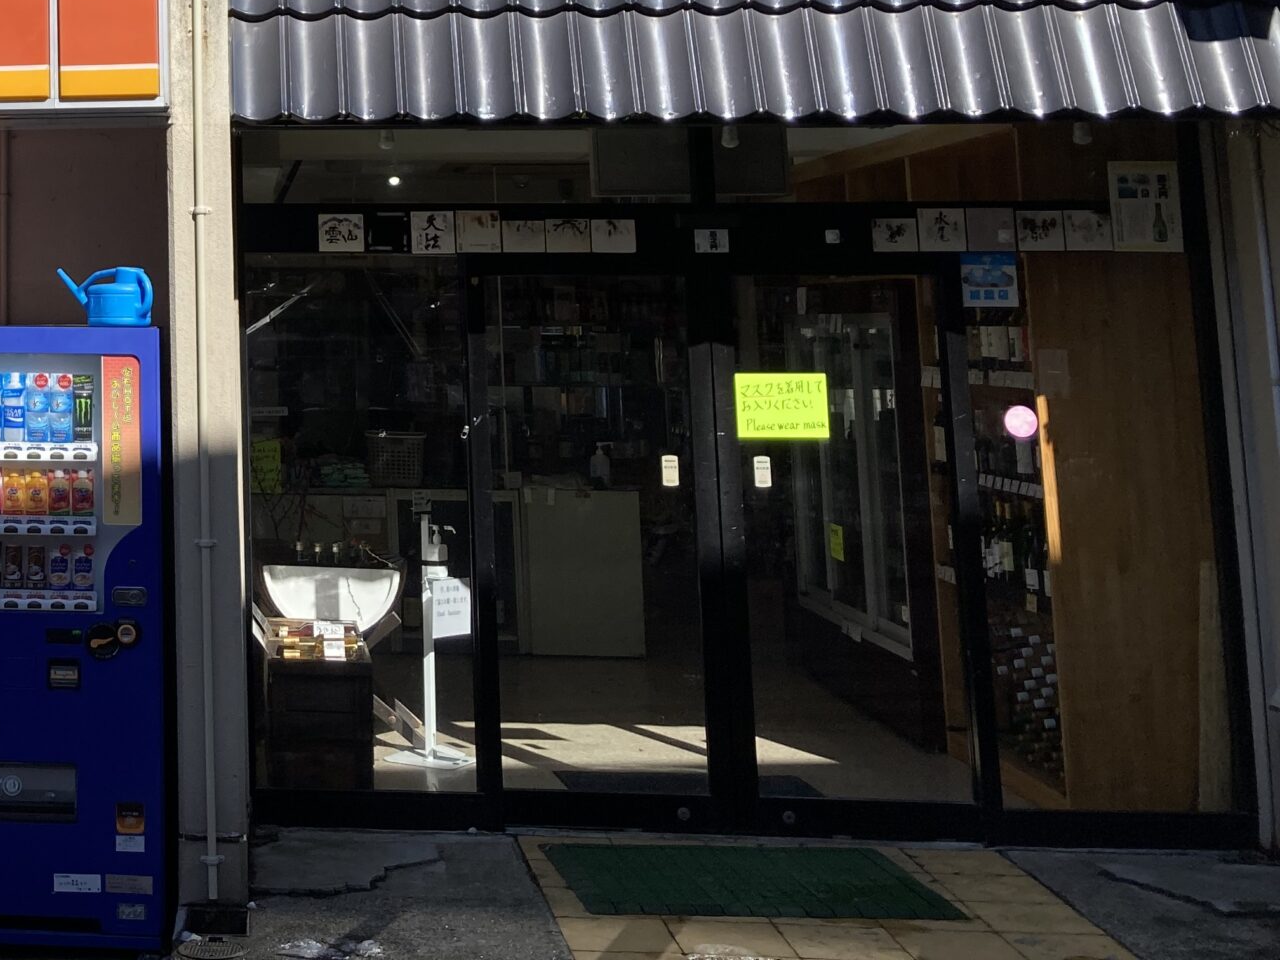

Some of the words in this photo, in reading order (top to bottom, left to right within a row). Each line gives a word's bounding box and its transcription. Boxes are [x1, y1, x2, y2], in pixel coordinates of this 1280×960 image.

[740, 380, 822, 398] マスクを着用して
[746, 418, 776, 432] Please
[777, 421, 800, 431] wear
[803, 421, 827, 430] mask
